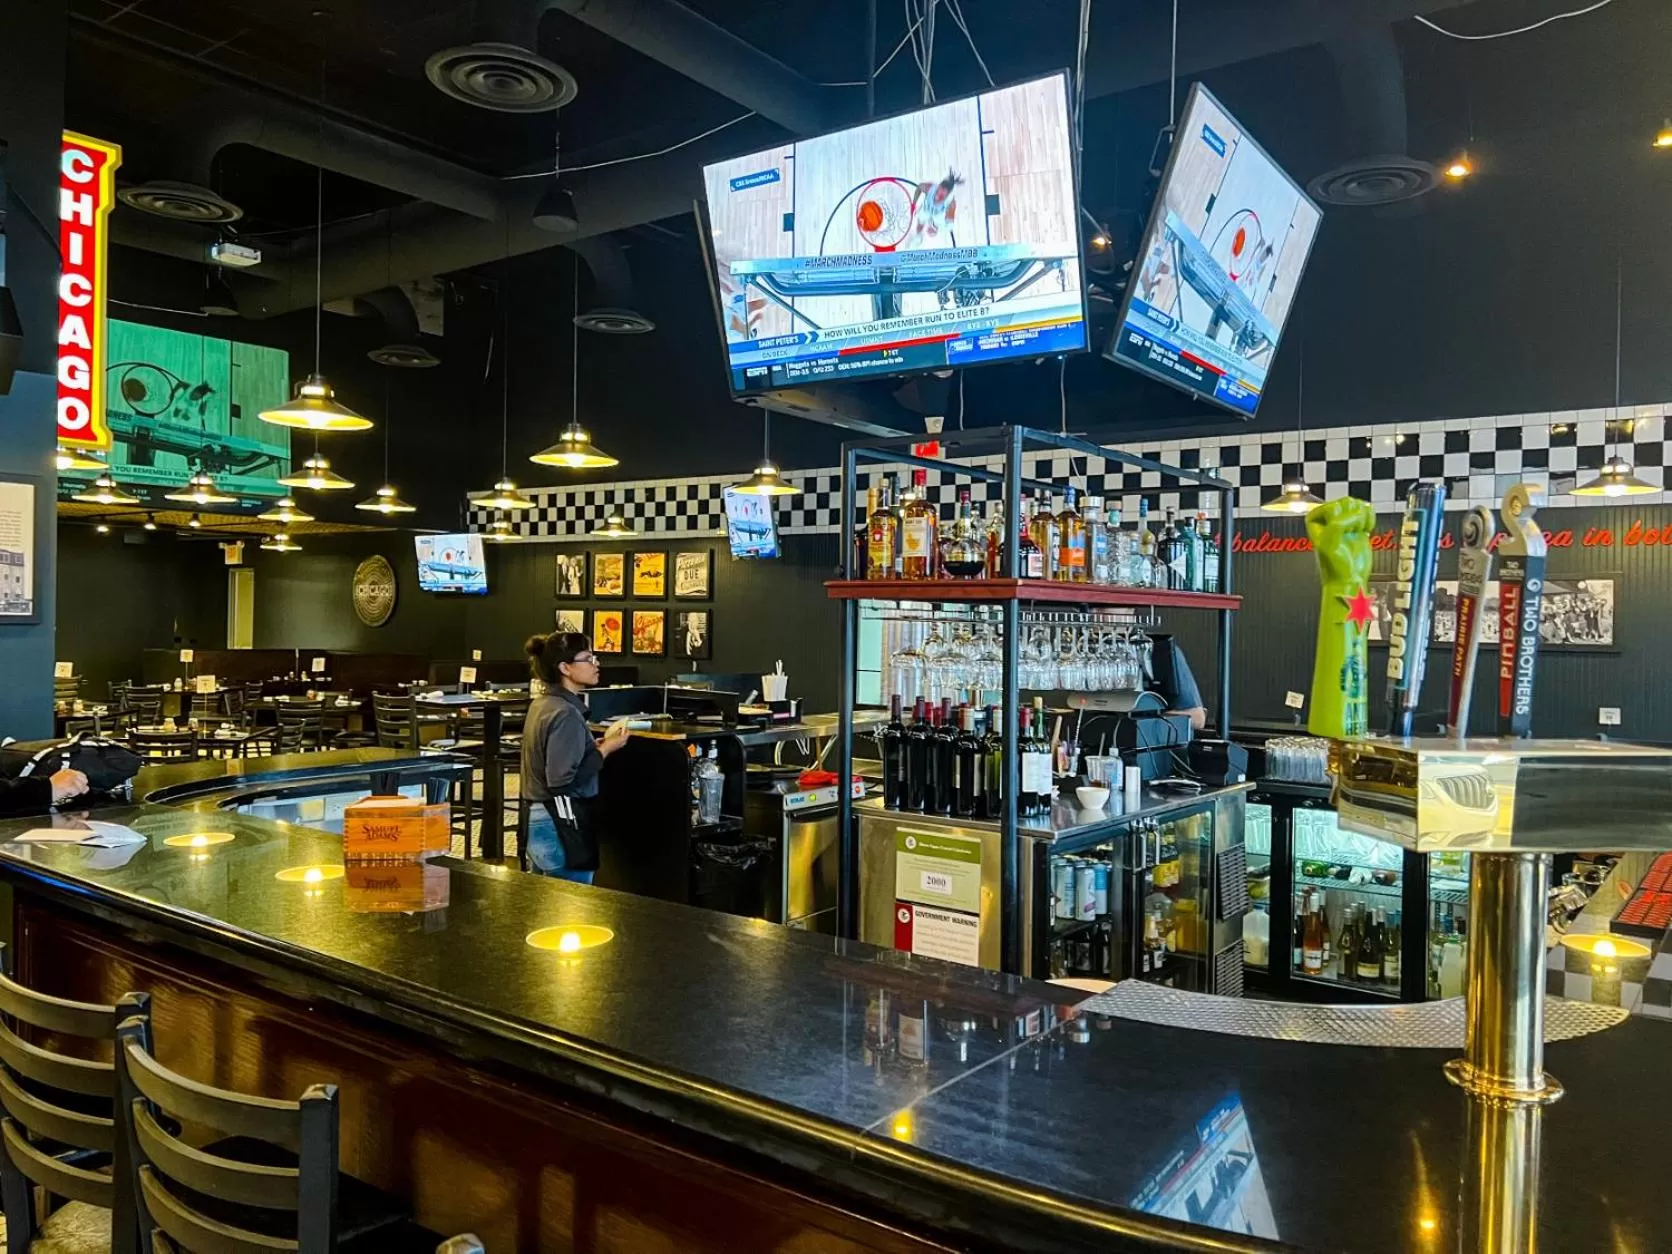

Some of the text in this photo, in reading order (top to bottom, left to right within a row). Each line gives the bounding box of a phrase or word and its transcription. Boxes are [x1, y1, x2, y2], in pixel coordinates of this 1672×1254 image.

[58, 148, 94, 431] CHICAGO
[825, 329, 844, 339] HOW
[844, 327, 862, 337] WILL
[863, 325, 880, 334] YOU
[880, 316, 924, 332] REMEMBER
[925, 314, 943, 325] RUN
[944, 312, 956, 322] TO
[957, 309, 978, 320] ELITE
[133, 466, 172, 477] REMEMBER
[1231, 530, 1314, 553] balanc
[1583, 526, 1615, 547] in
[1624, 519, 1672, 547] bot
[1386, 520, 1420, 680] BUD LIGHT
[1453, 597, 1470, 677] PRAIRIE PATH
[1515, 596, 1539, 715] TWO BROTHERS
[915, 910, 978, 929] GOVERNMENT WARNING
